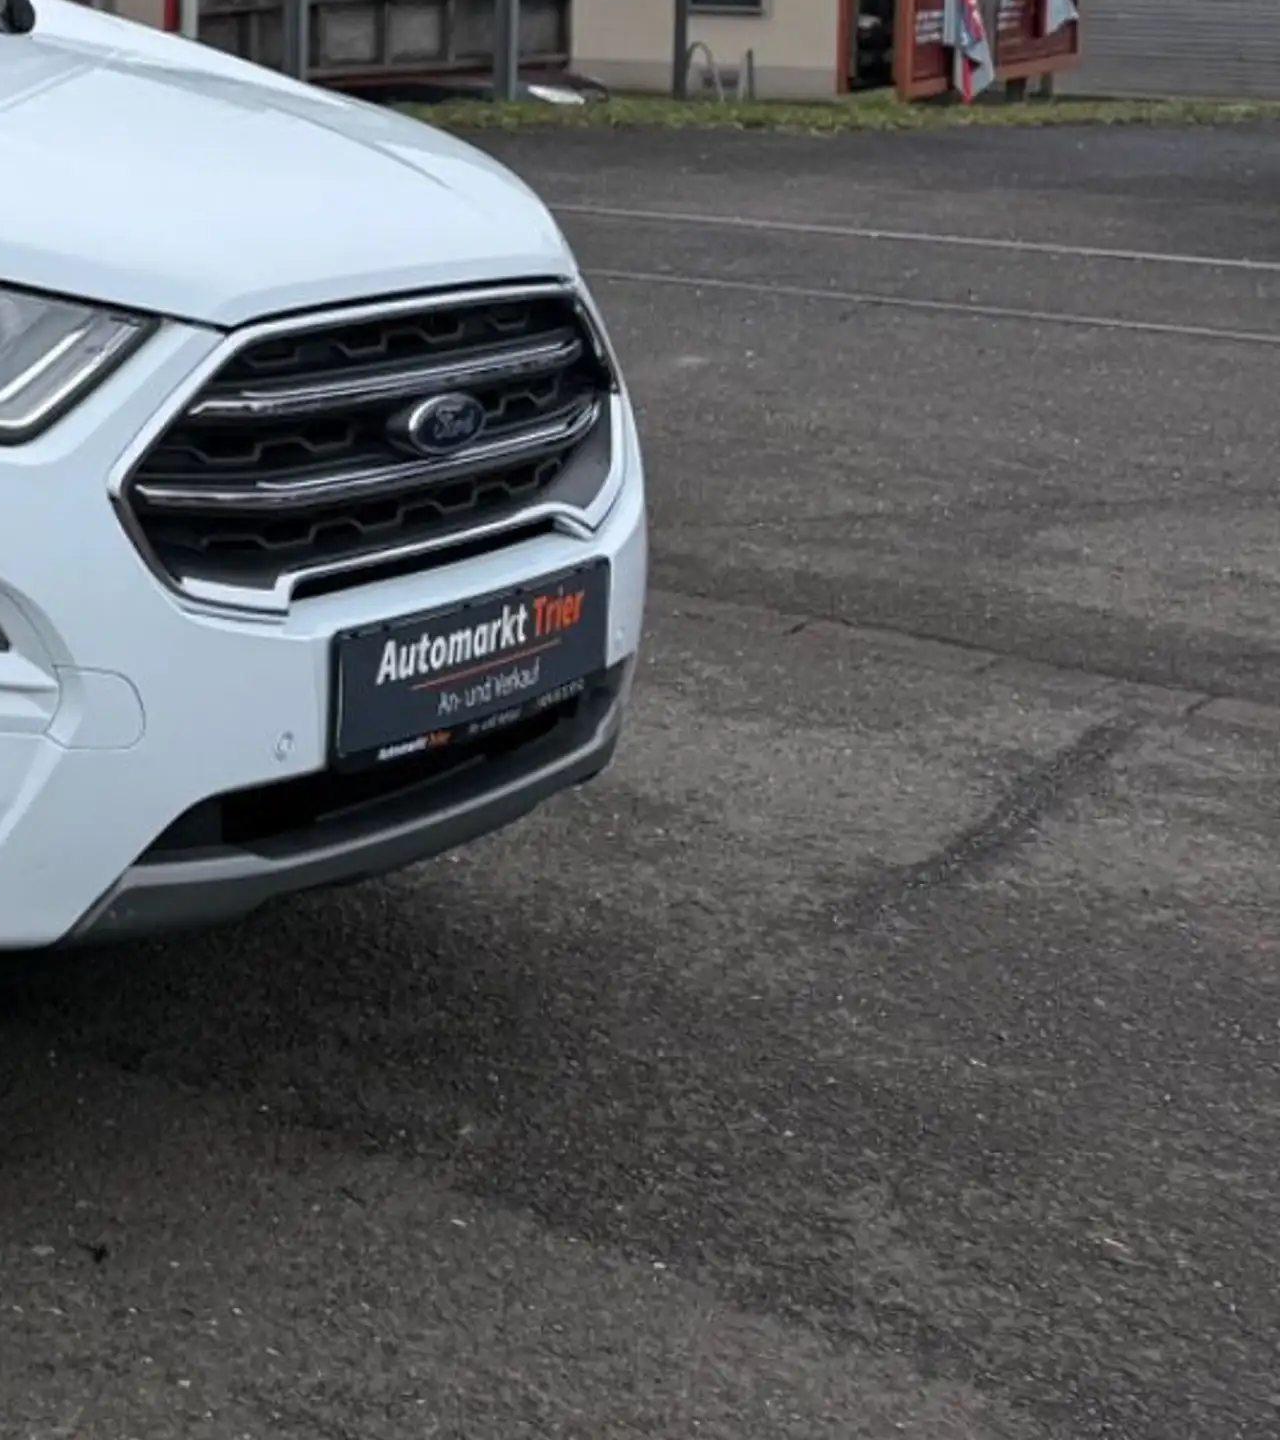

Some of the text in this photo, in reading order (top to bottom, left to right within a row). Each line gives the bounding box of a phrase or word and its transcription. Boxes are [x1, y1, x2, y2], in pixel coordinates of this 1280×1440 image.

[375, 584, 585, 686] Automarkt Trier
[437, 689, 462, 717] An-
[464, 676, 491, 707] und
[491, 656, 541, 696] Verkauf
